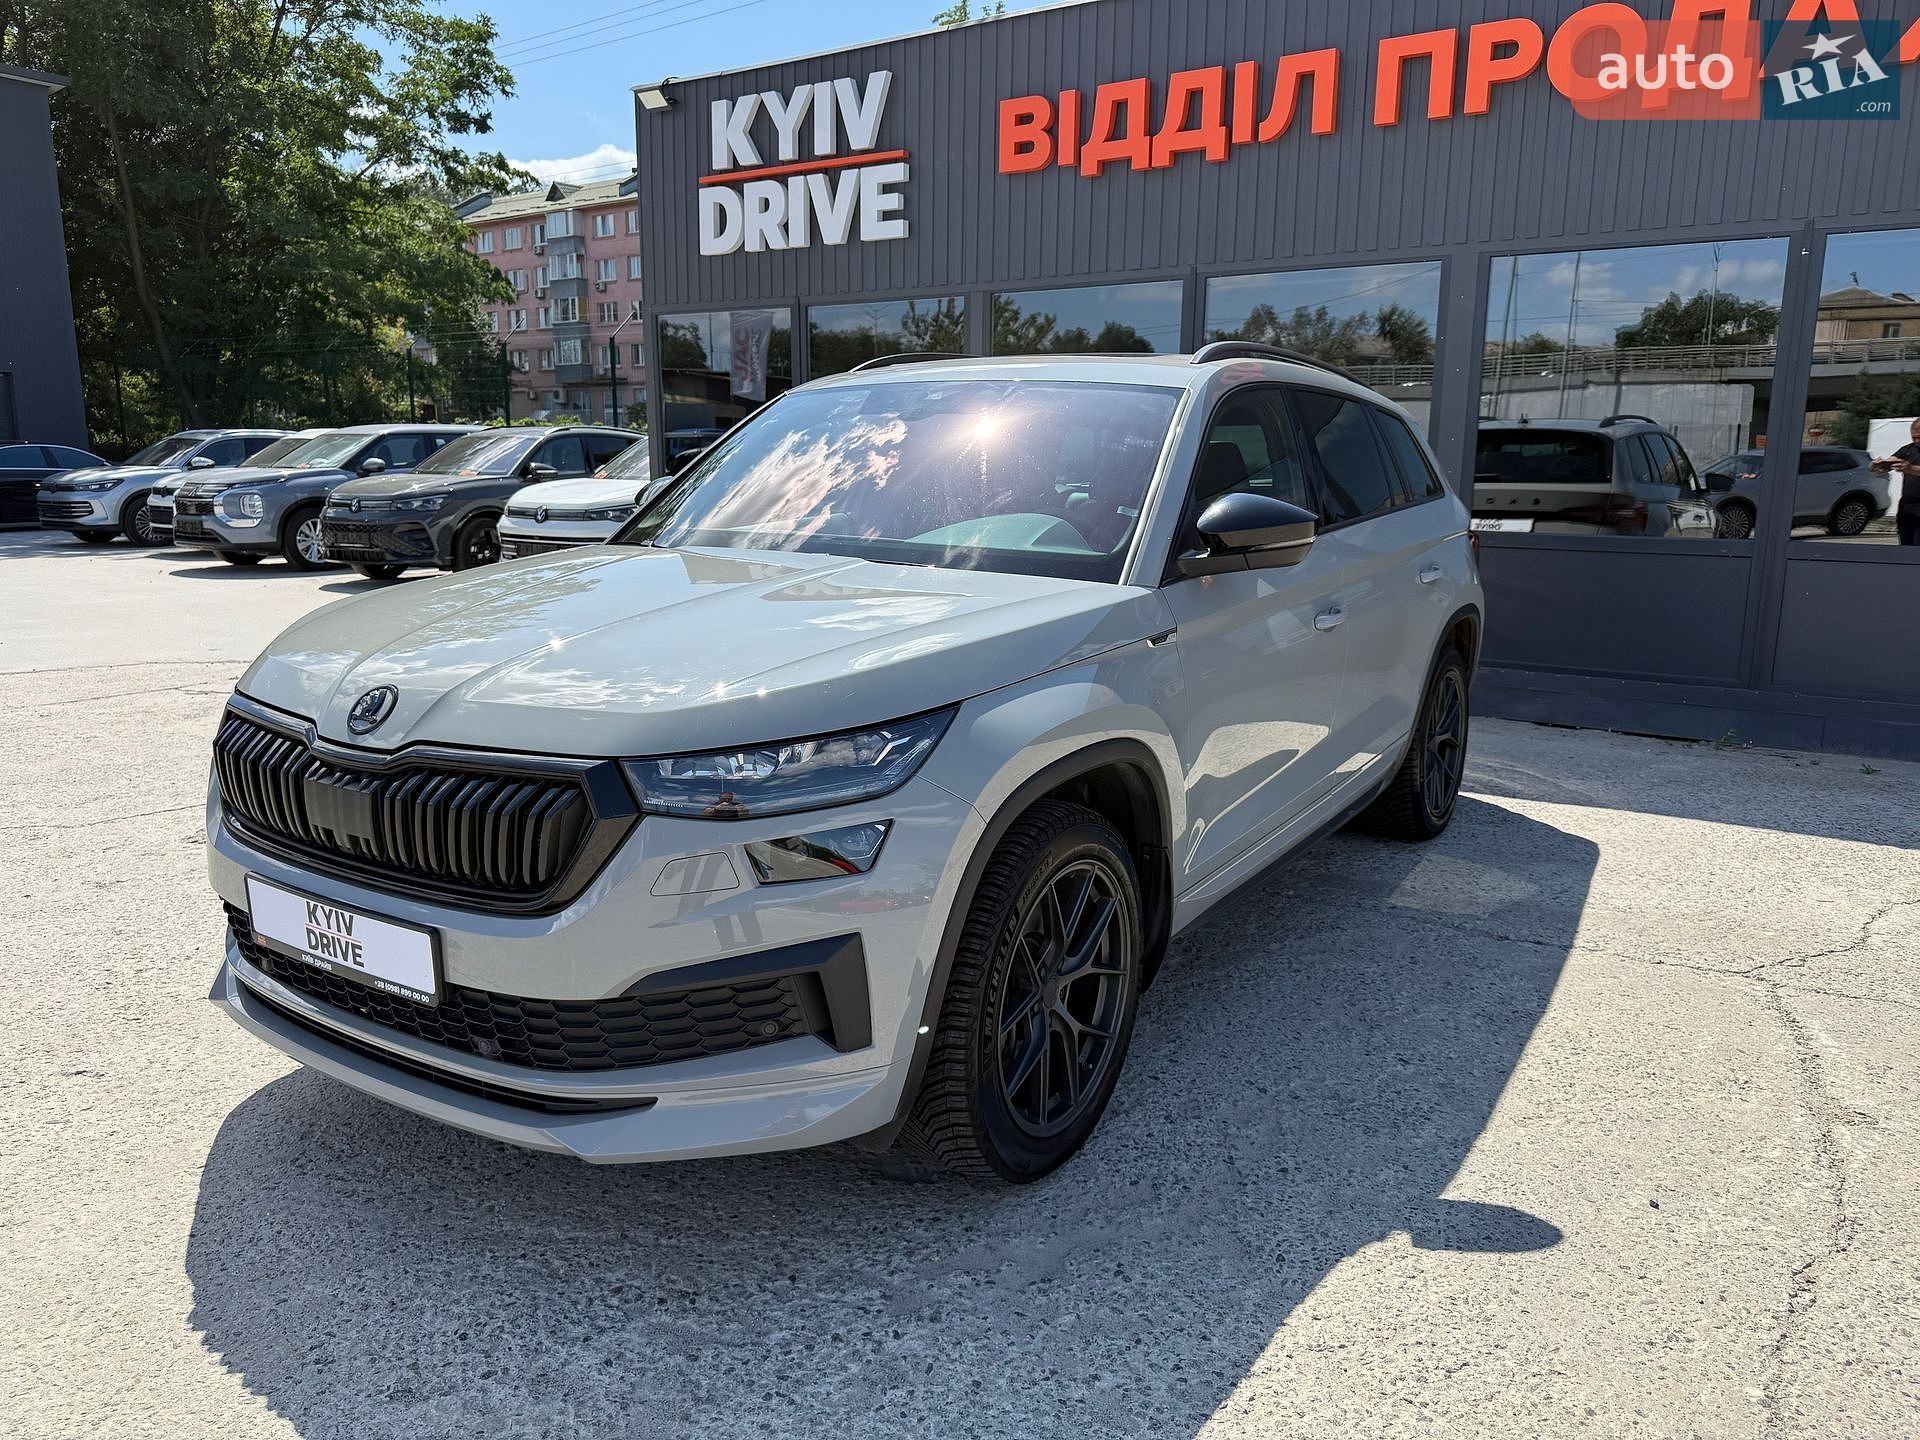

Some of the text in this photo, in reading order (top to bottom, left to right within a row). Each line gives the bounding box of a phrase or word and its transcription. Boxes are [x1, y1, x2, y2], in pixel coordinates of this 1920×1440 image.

[711, 70, 893, 170] KYIV
[999, 48, 1341, 177] ВІДДІЛ
[699, 162, 909, 256] DRIVE
[305, 900, 354, 937] KYIV
[305, 926, 365, 968] DRIVE
[984, 909, 1019, 1037] MICHELIN
